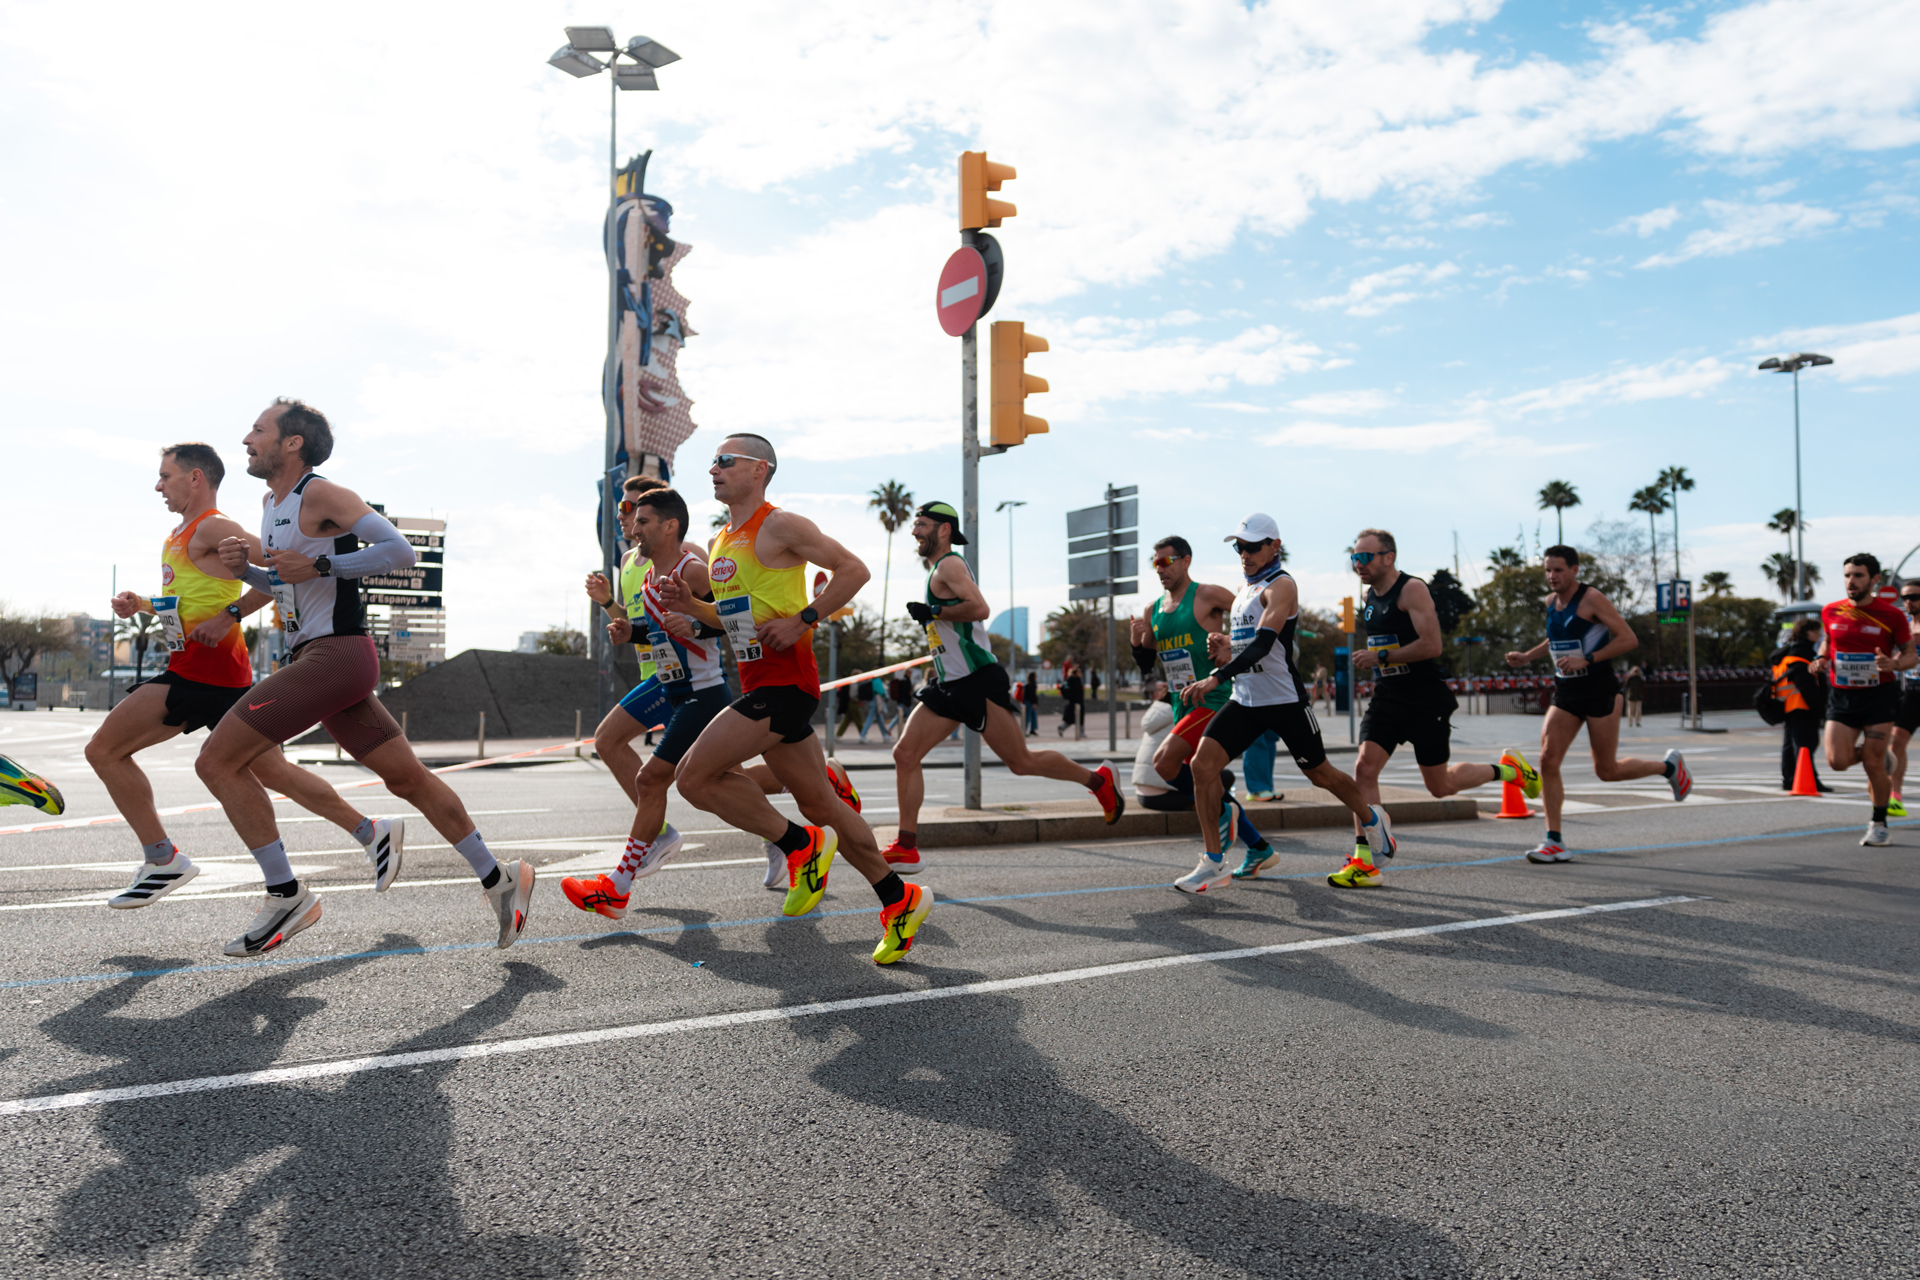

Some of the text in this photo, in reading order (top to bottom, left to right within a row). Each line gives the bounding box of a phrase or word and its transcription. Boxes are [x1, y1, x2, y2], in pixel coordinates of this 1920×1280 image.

[405, 535, 426, 545] orbó
[361, 576, 409, 588] Catalunya
[369, 593, 418, 607] d'Espanya
